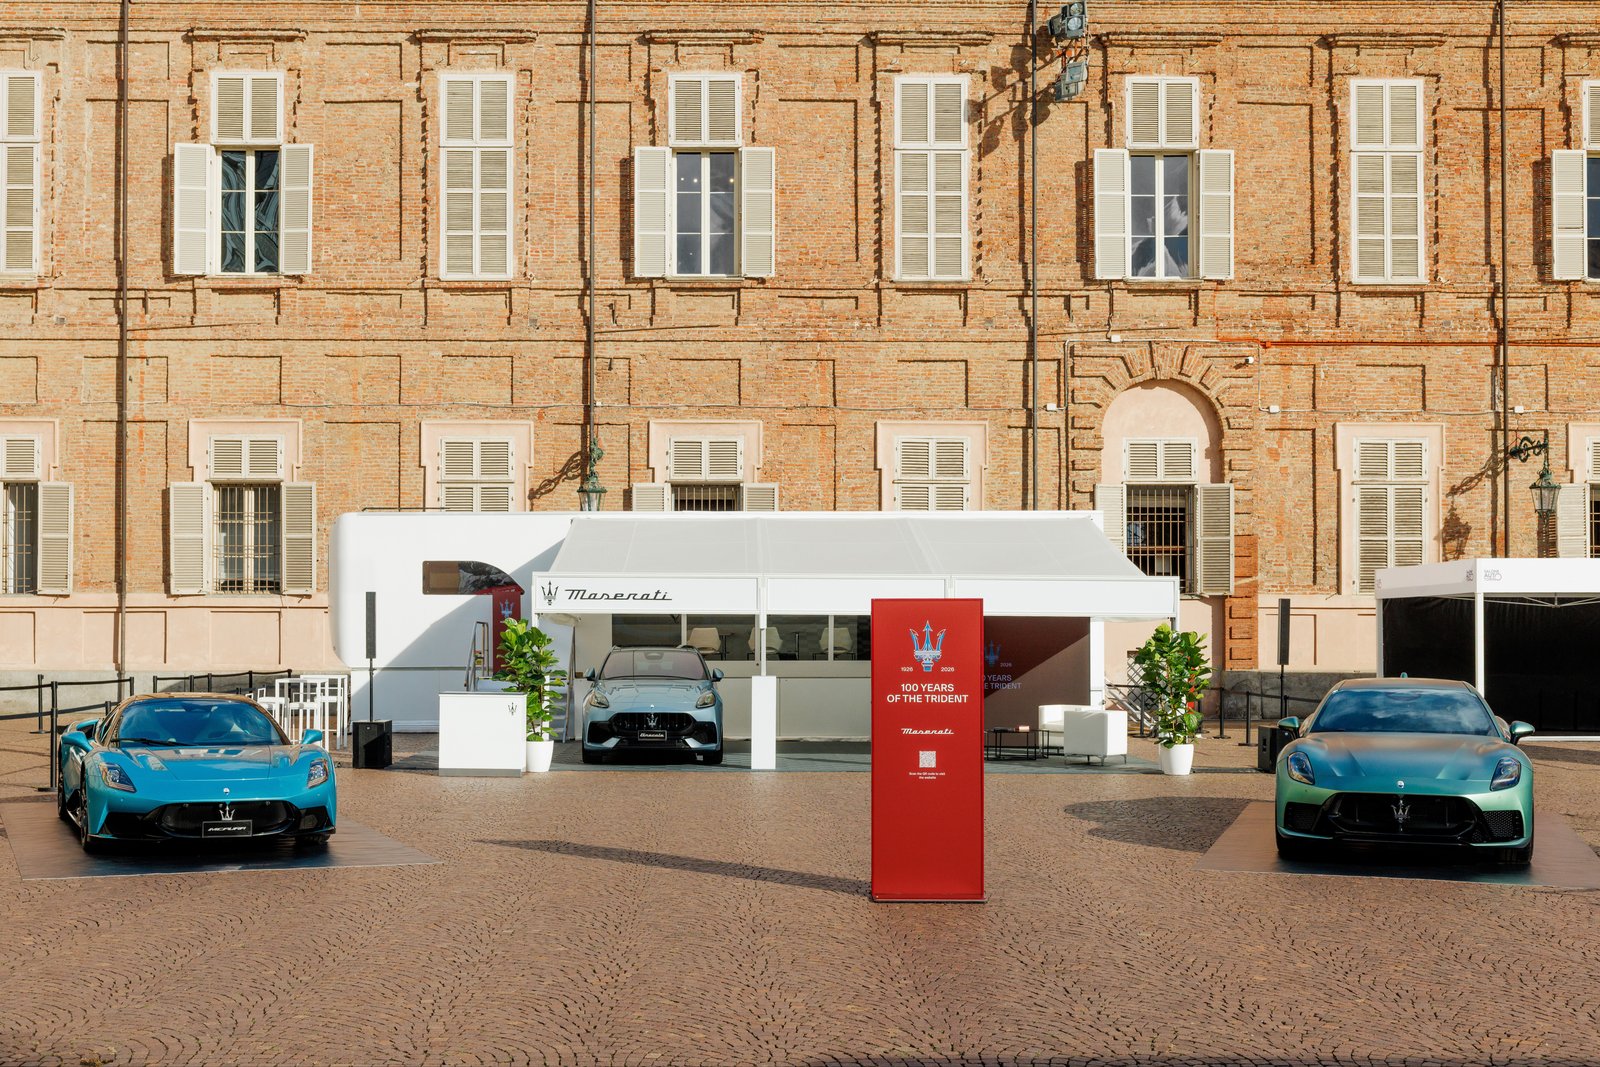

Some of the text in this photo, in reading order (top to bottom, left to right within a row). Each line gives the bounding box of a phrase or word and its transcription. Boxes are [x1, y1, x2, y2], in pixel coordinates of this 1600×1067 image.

[564, 589, 673, 601] Maserati
[987, 674, 1012, 682] YEARS
[901, 683, 955, 692] 100 YEARS
[990, 682, 1022, 690] TRIDENT
[886, 694, 969, 703] OF THE TRIDENT
